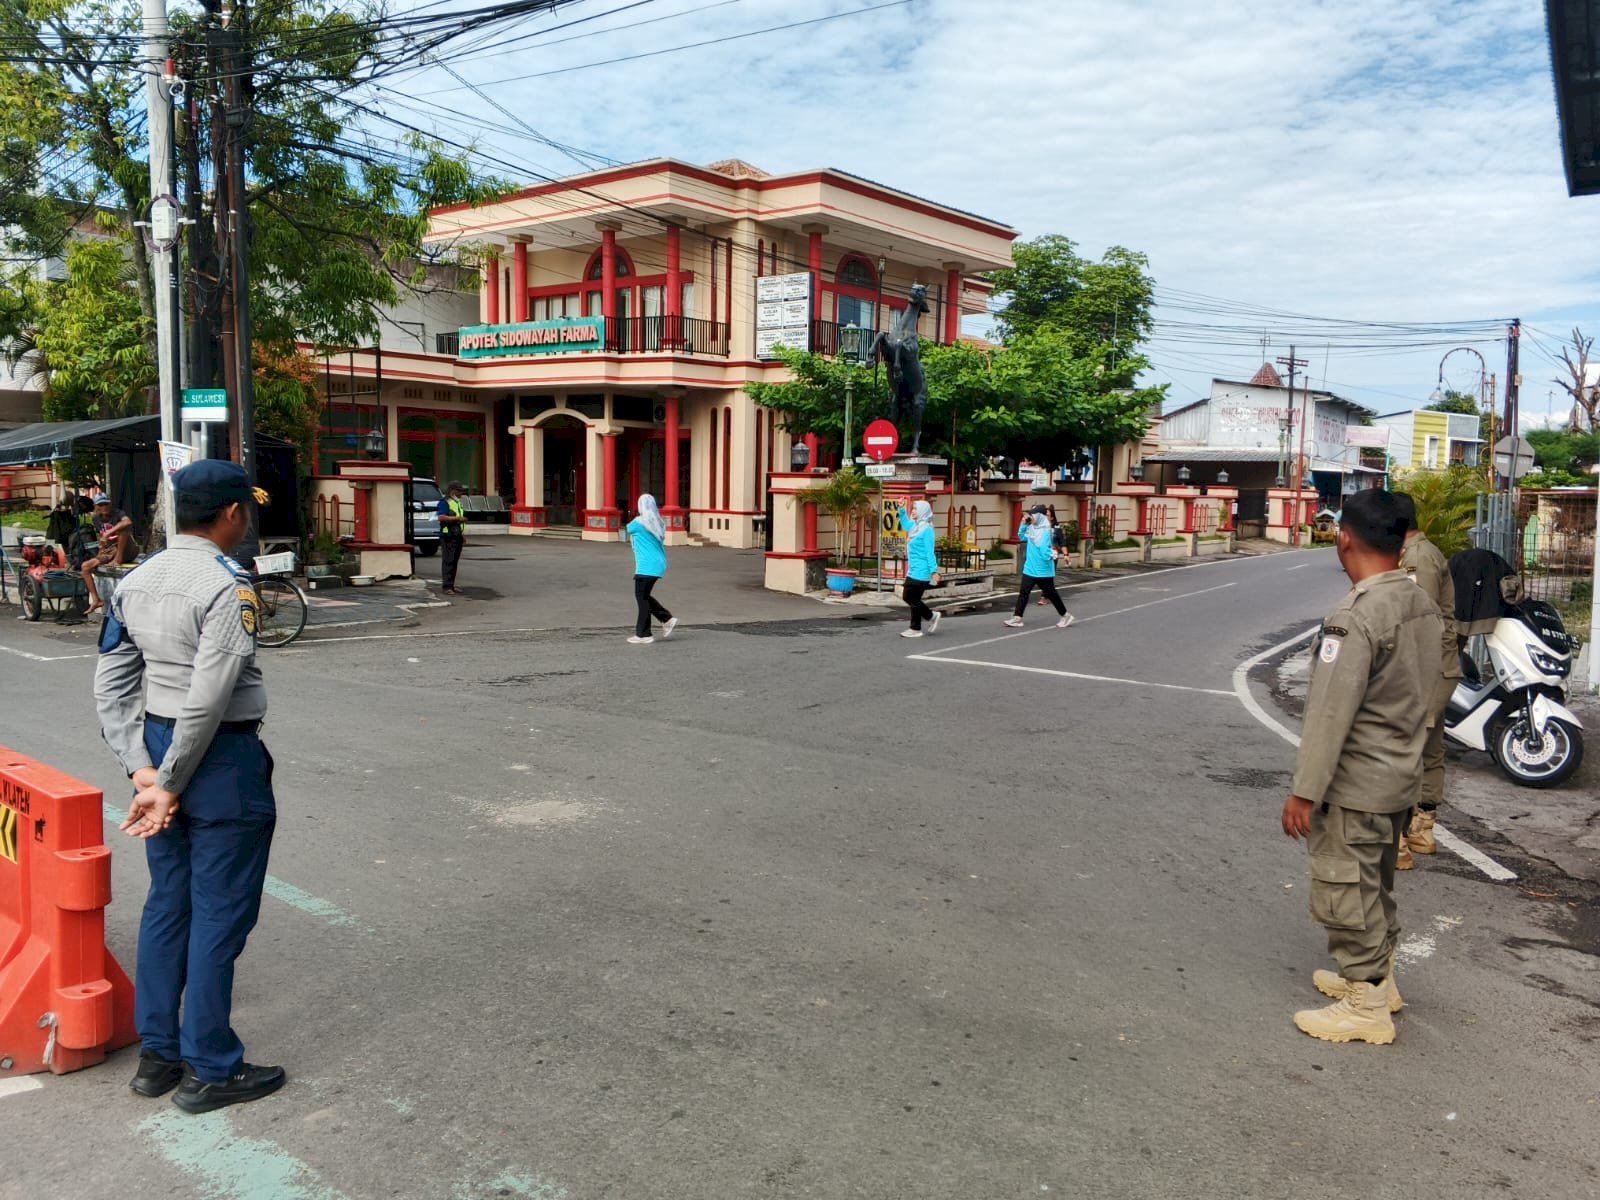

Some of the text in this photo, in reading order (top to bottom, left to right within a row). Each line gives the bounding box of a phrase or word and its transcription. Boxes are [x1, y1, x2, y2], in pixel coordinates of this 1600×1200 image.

[461, 326, 597, 349] APOTEK SIDOWAYAH FARMA
[191, 394, 224, 404] SULAWESI
[2, 779, 30, 815] KLATEN
